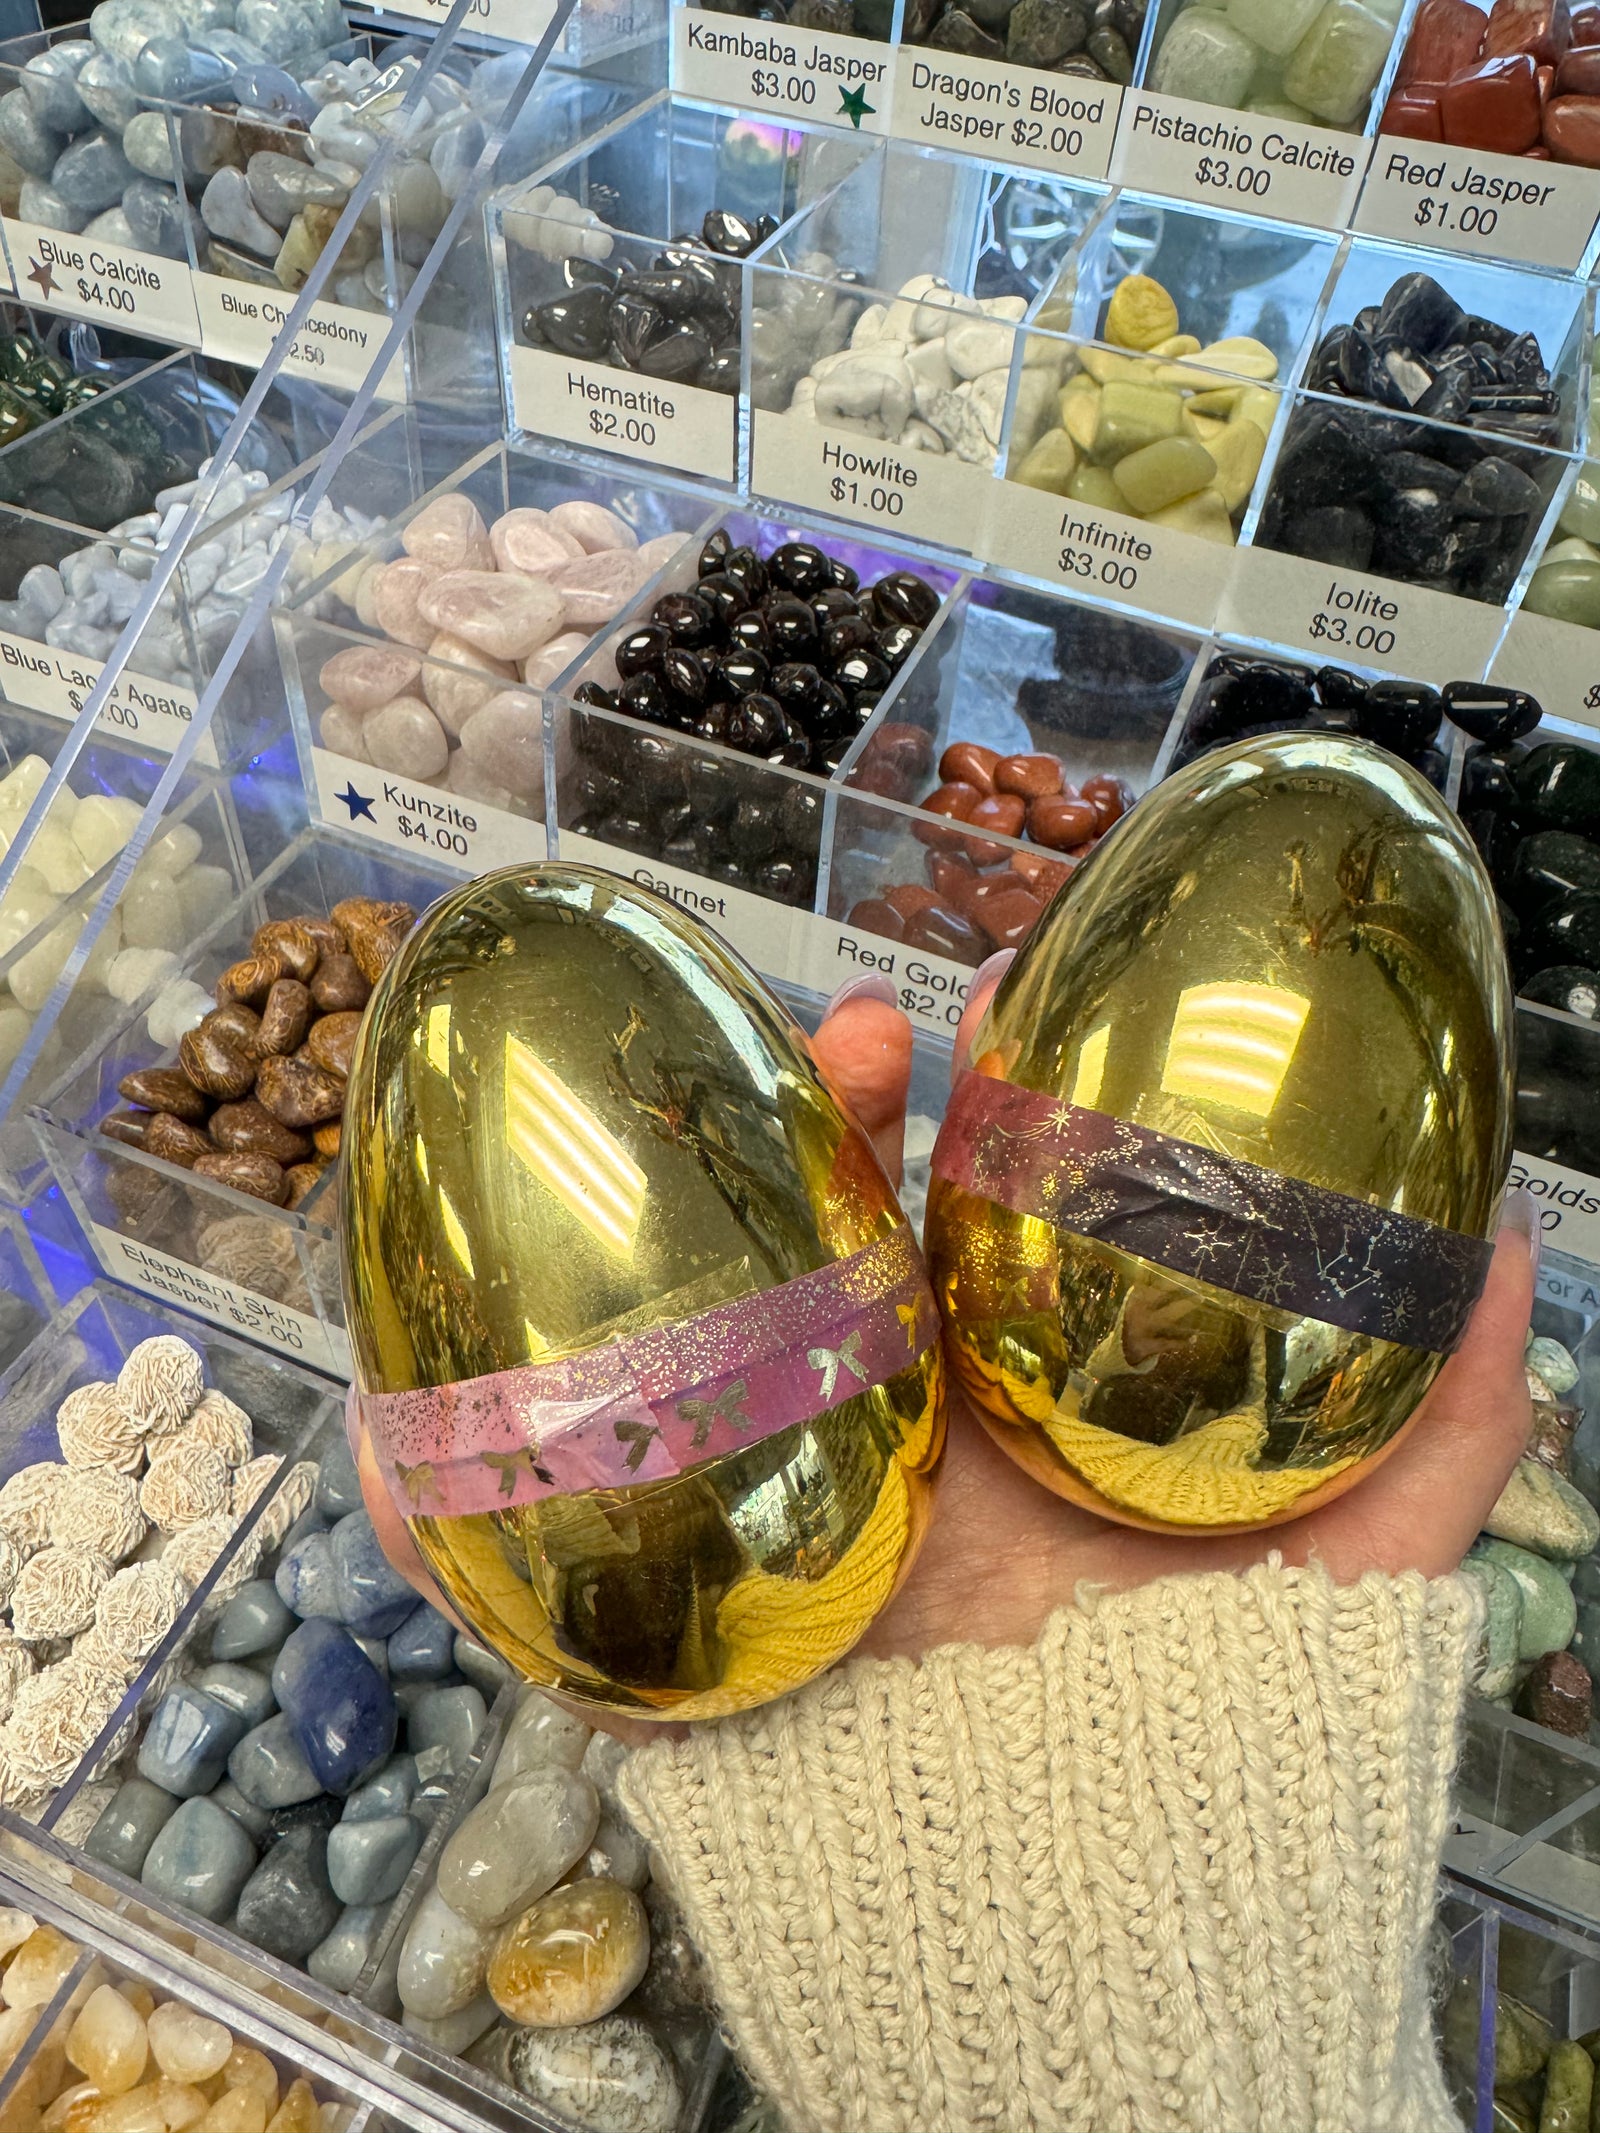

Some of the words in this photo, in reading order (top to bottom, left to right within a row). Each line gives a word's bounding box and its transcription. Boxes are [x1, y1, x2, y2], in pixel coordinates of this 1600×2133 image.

[687, 22, 797, 66] Kambaba
[804, 45, 887, 82] Jasper
[751, 69, 816, 105] $3.00
[912, 63, 1020, 109] Dragon's
[1030, 86, 1105, 124] Blood
[920, 102, 1005, 141] Jasper
[1011, 119, 1083, 156] $2.00
[1132, 105, 1252, 155] Pistachio
[1261, 134, 1355, 177] Calcite
[1195, 157, 1271, 196] $3.00
[1385, 153, 1447, 188] Red
[1451, 167, 1556, 207] Jasper
[1414, 197, 1498, 236] $1.00
[38, 238, 85, 271] Blue
[89, 251, 161, 290] Calcite
[77, 278, 135, 313] $4.00
[221, 293, 258, 318] Blue
[262, 303, 368, 348] Chcedony
[271, 336, 325, 366] 2.50
[567, 372, 675, 419] Hematite
[589, 409, 656, 446] $2.00
[822, 441, 918, 488] Howlite
[830, 477, 903, 516] $1.00
[1059, 513, 1152, 562] Infinite
[1057, 547, 1137, 591] $3.00
[1326, 582, 1398, 622] Iolite
[1308, 612, 1396, 654] $3.00
[0, 643, 51, 676] Blue
[128, 684, 192, 721] Agate
[68, 690, 138, 730] $.00
[383, 782, 478, 833] Kunzite
[398, 815, 469, 857] $4.00
[633, 869, 726, 917] Garnet
[837, 936, 895, 974] Red
[121, 1242, 237, 1304] Elephant
[243, 1296, 302, 1334] Skin
[138, 1268, 220, 1313] Jasper
[230, 1305, 303, 1350] $2.00
